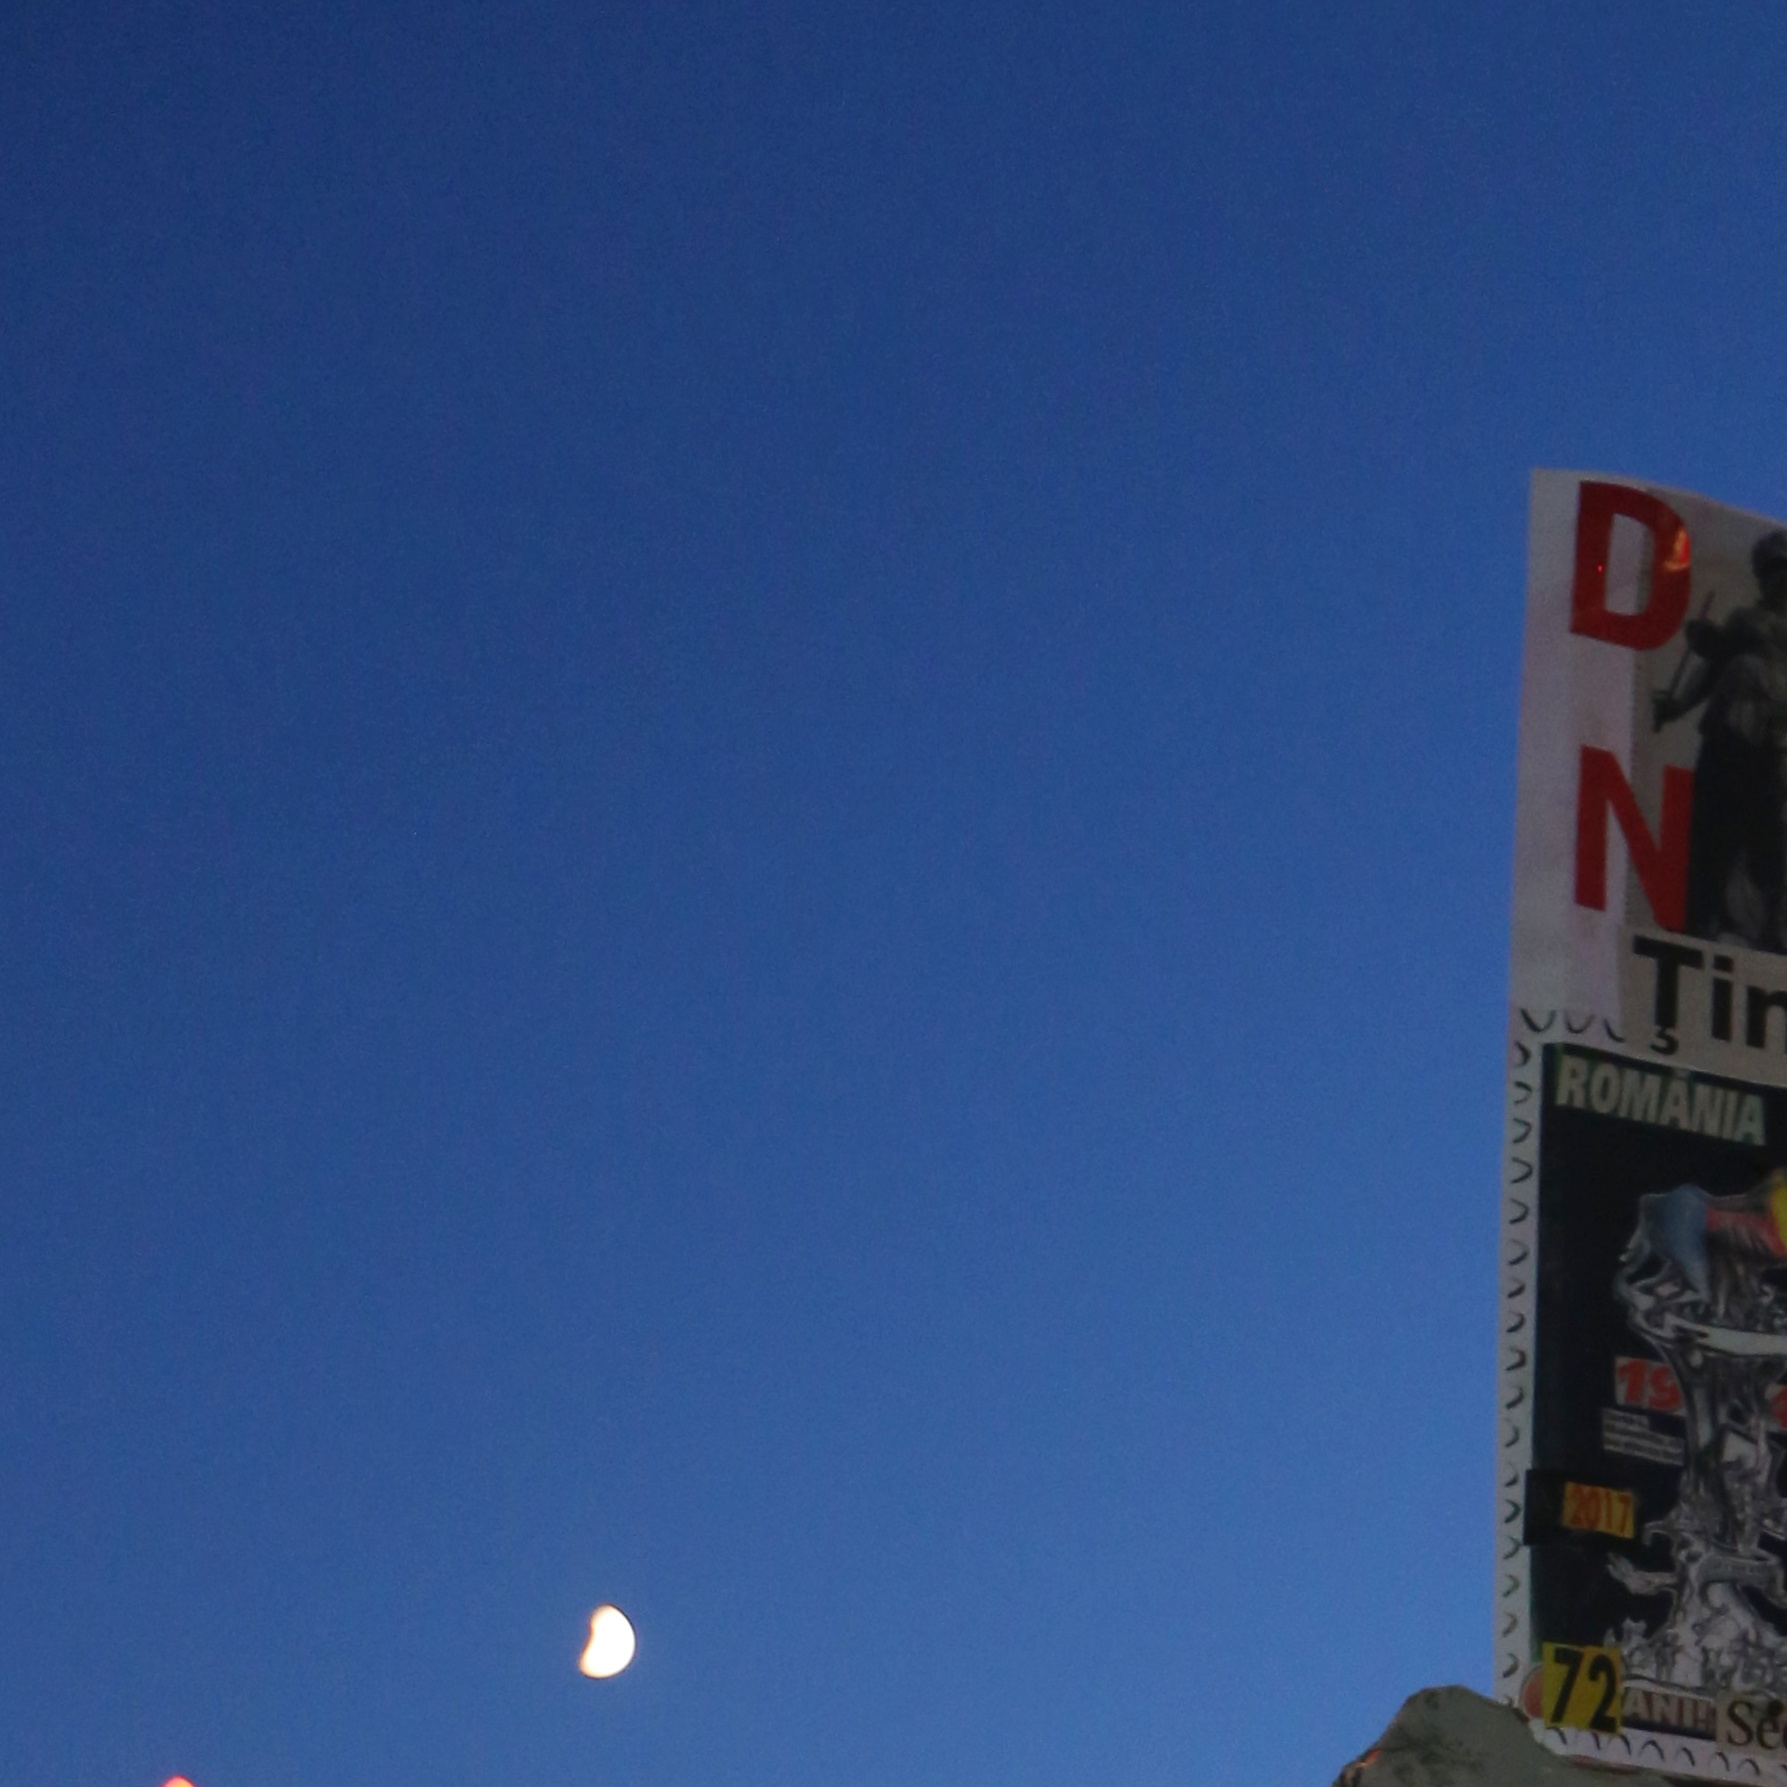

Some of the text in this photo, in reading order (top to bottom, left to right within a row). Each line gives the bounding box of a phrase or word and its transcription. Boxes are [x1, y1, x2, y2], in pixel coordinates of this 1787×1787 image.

[1569, 479, 1693, 650] D
[1574, 745, 1695, 932] N
[1555, 1056, 1766, 1146] ROMÂNIA
[1617, 1359, 1682, 1412] 19
[1571, 1485, 1630, 1532] 2017
[1551, 1648, 1617, 1732] 72
